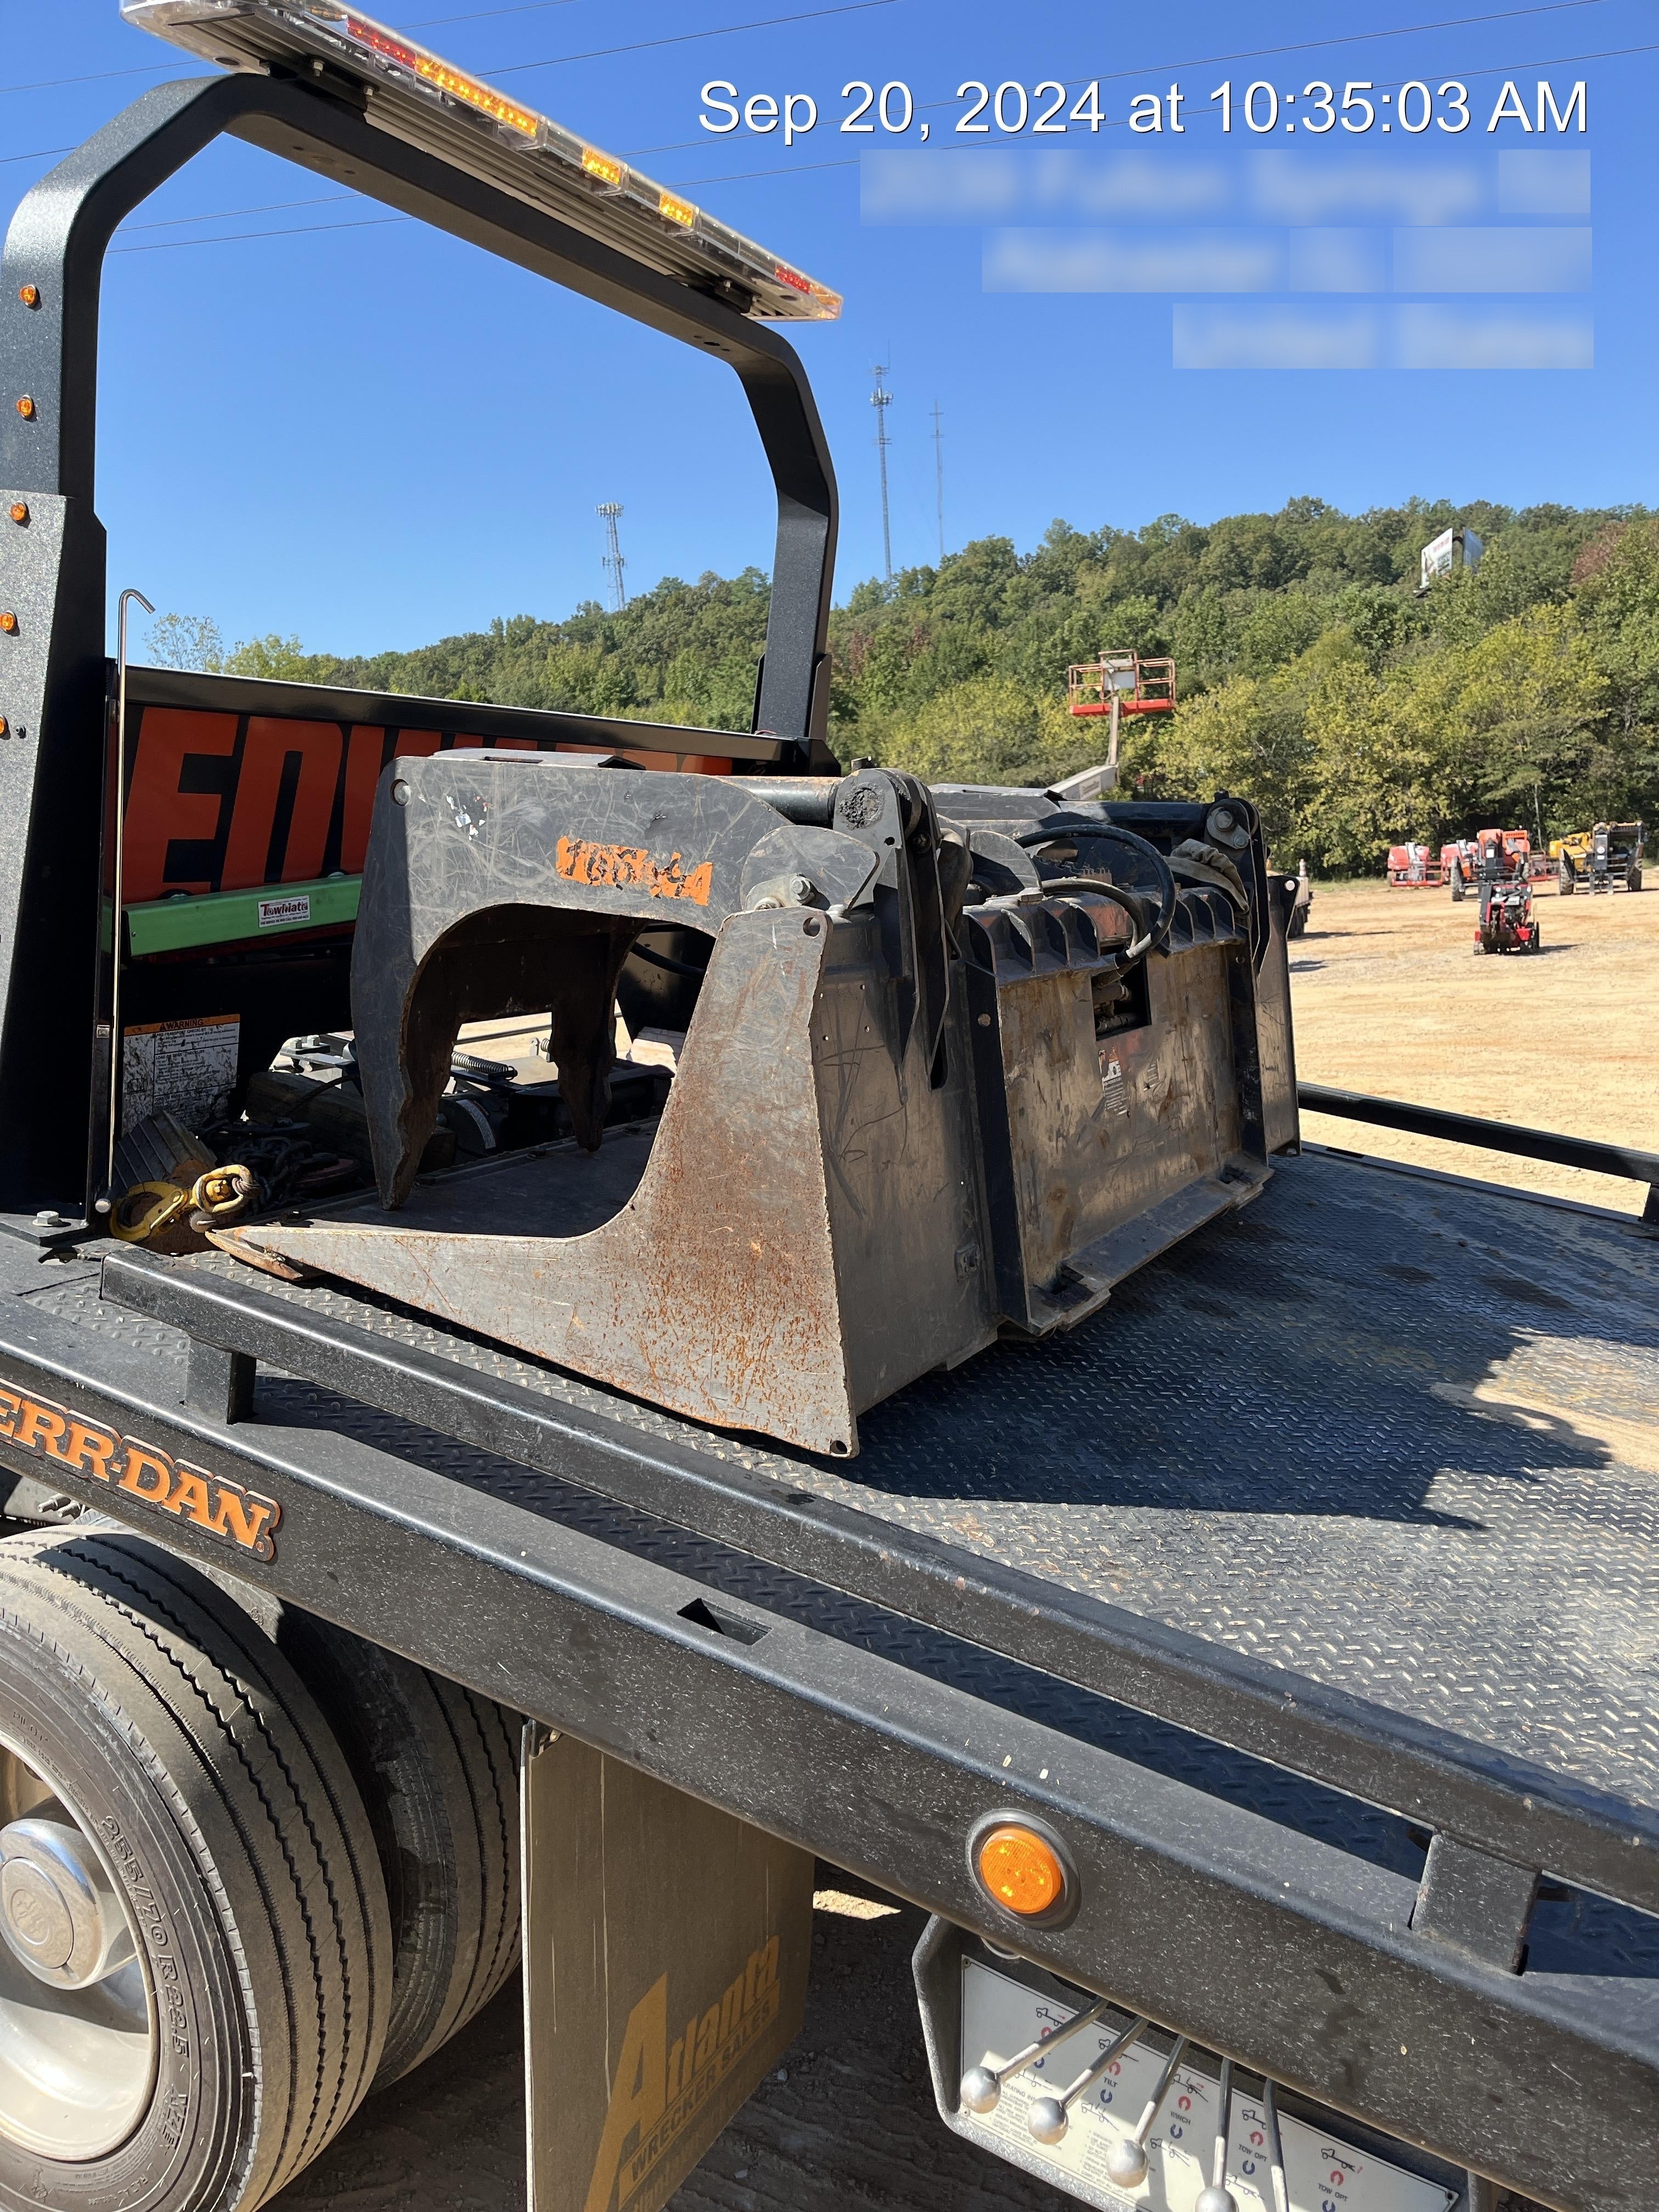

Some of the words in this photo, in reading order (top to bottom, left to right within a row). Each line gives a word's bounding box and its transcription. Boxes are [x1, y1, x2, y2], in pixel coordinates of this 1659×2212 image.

[166, 1019, 204, 1029] WARNING
[101, 1815, 168, 1946] 255/70
[1000, 2081, 1026, 2097] ERATING
[1103, 2076, 1118, 2088] TILT
[631, 2069, 715, 2182] WRECKER
[1170, 2111, 1191, 2126] WINCH
[1238, 2144, 1252, 2155] TOW
[1254, 2152, 1268, 2163] OPT
[1317, 2182, 1333, 2194] TOW
[1335, 2191, 1348, 2202] OPT
